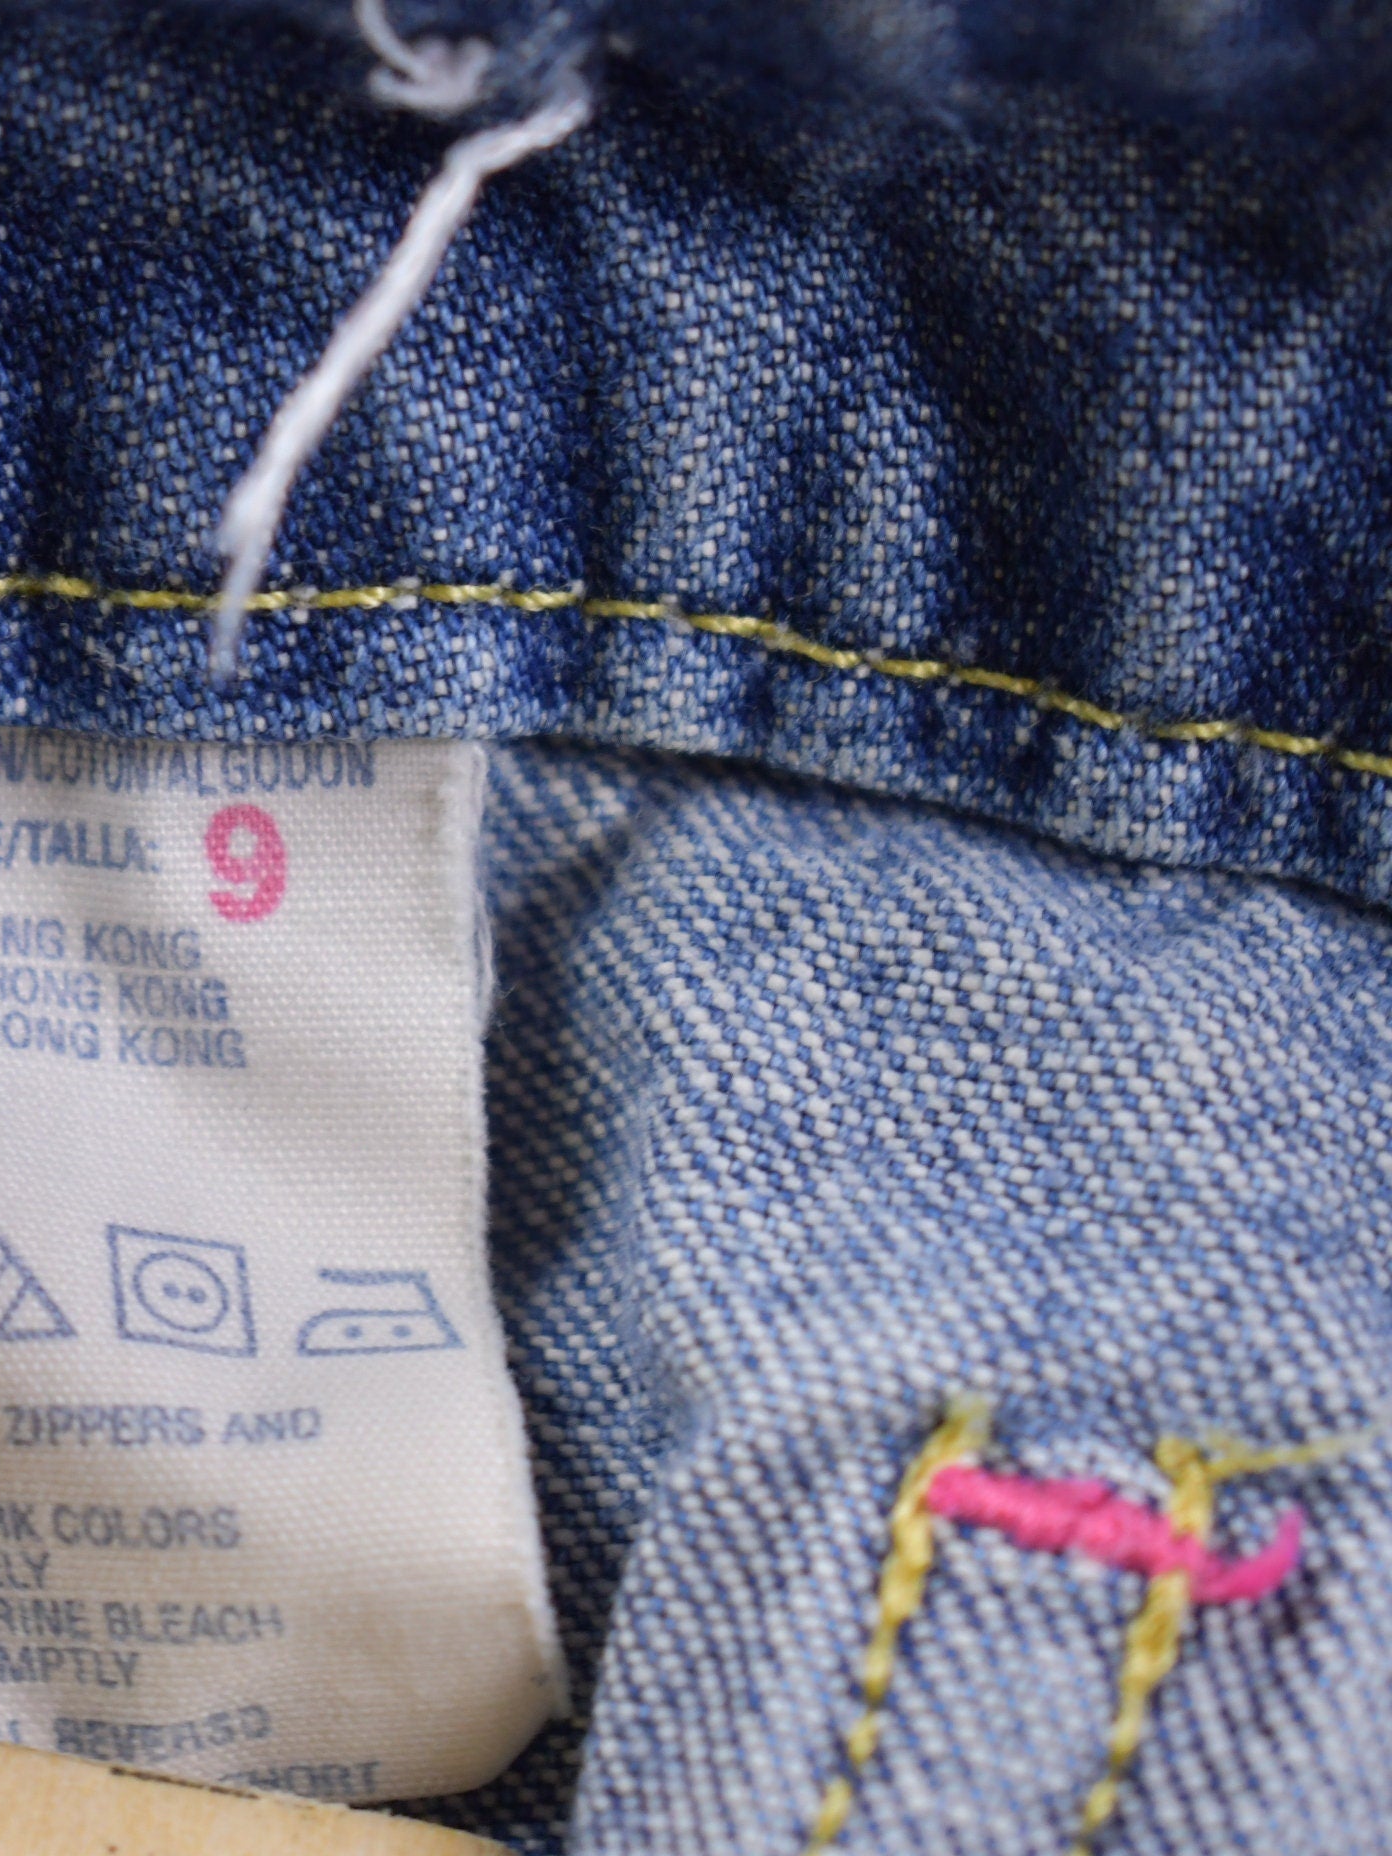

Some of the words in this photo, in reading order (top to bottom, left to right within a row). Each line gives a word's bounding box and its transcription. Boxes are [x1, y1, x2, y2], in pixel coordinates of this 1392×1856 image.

[204, 803, 287, 923] 9
[83, 921, 203, 970] KONG
[118, 973, 229, 1022] KONG
[118, 1024, 247, 1069] KONG
[4, 1403, 206, 1447] ZIPPERS
[222, 1405, 322, 1445] AND
[53, 1503, 243, 1549] COLORS
[102, 1601, 285, 1645] BLEACH
[218, 1760, 381, 1800] HORT
